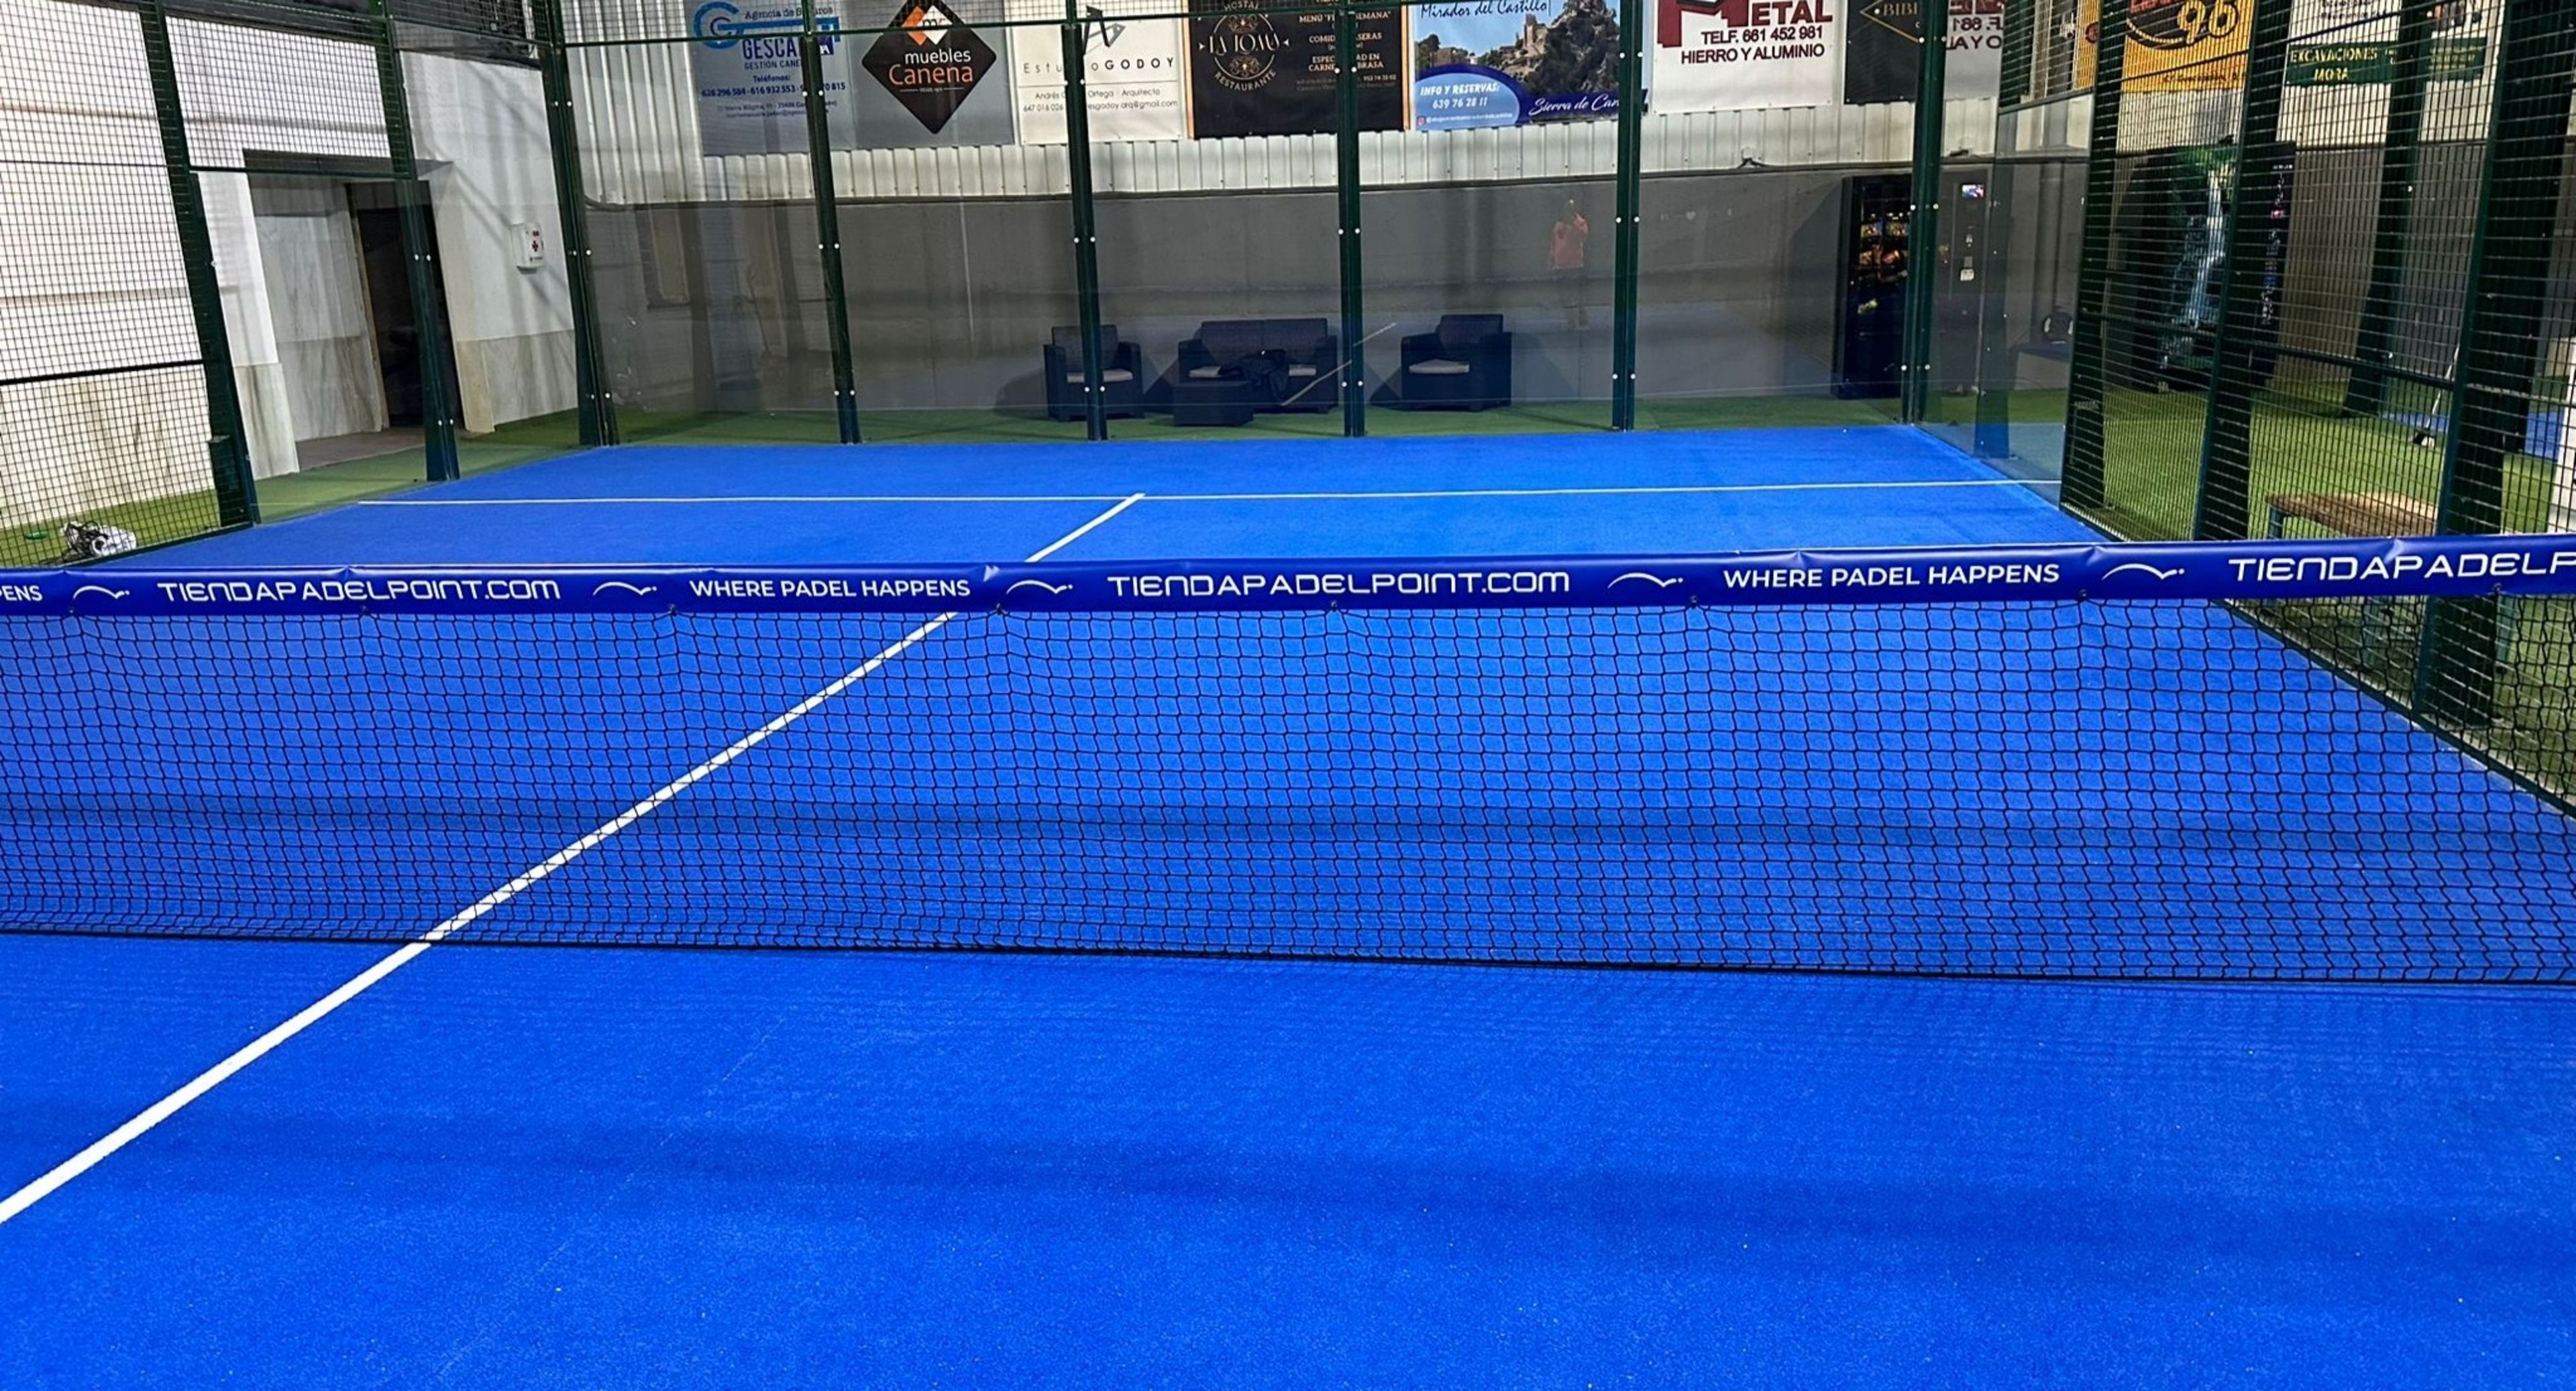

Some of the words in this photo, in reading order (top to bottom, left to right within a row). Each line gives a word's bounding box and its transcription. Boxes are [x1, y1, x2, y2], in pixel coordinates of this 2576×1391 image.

[1420, 3, 1471, 19] Mirador
[1474, 0, 1493, 16] del
[1497, 0, 1548, 15] Castillo
[1701, 30, 1739, 45] TELF.
[1770, 27, 1796, 41] 452
[1799, 25, 1823, 39] 981
[742, 35, 798, 60] GESCA
[905, 48, 972, 64] muebles
[1680, 48, 1738, 64] HIERRO
[1741, 47, 1752, 61] Y
[1752, 43, 1825, 61] ALUMINIO
[780, 58, 801, 68] CANE
[888, 64, 973, 86] Canena
[1214, 68, 1277, 91] RESTAURANTE
[1419, 86, 1443, 97] INFO
[1444, 85, 1451, 95] Y
[1452, 82, 1501, 95] RESERVAS:
[1432, 99, 1450, 109] 639
[1528, 97, 1572, 116] Sierra
[1574, 95, 1589, 110] de
[1723, 568, 1817, 589] WHERE
[1831, 566, 1921, 587] PADEL
[1928, 563, 2059, 585] HAPPENS
[0, 585, 43, 602] ENS
[689, 579, 776, 597] WHERE
[780, 579, 857, 597] PADEL
[861, 579, 971, 597] HAPPENS
